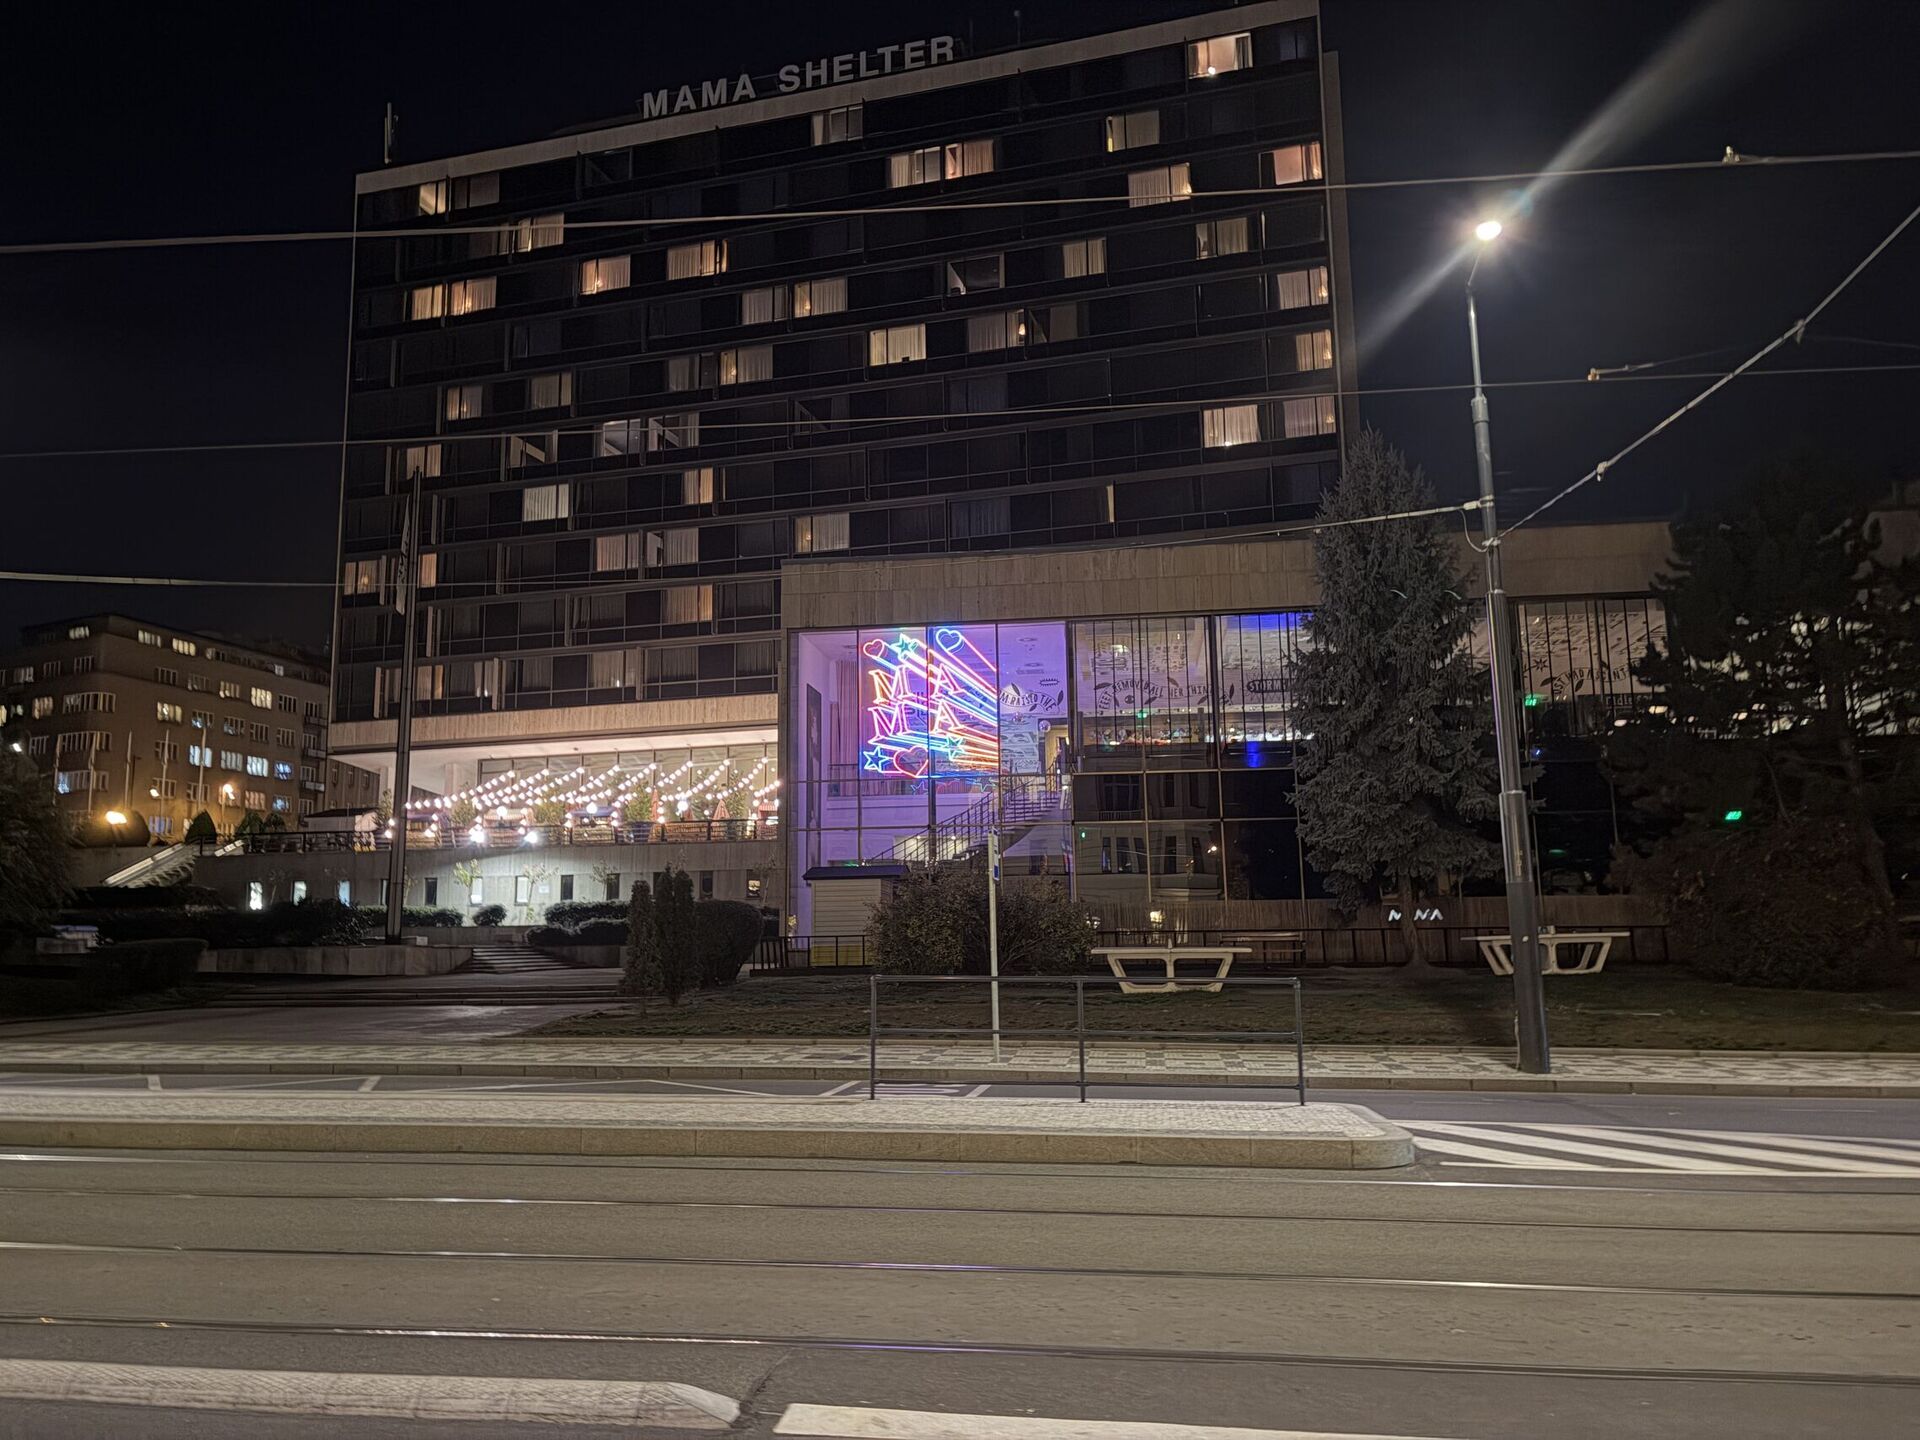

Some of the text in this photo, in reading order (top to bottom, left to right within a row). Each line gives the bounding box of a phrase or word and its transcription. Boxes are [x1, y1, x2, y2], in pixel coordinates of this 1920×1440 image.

[643, 35, 955, 120] MAMA SHELTER
[1040, 694, 1057, 711] THE
